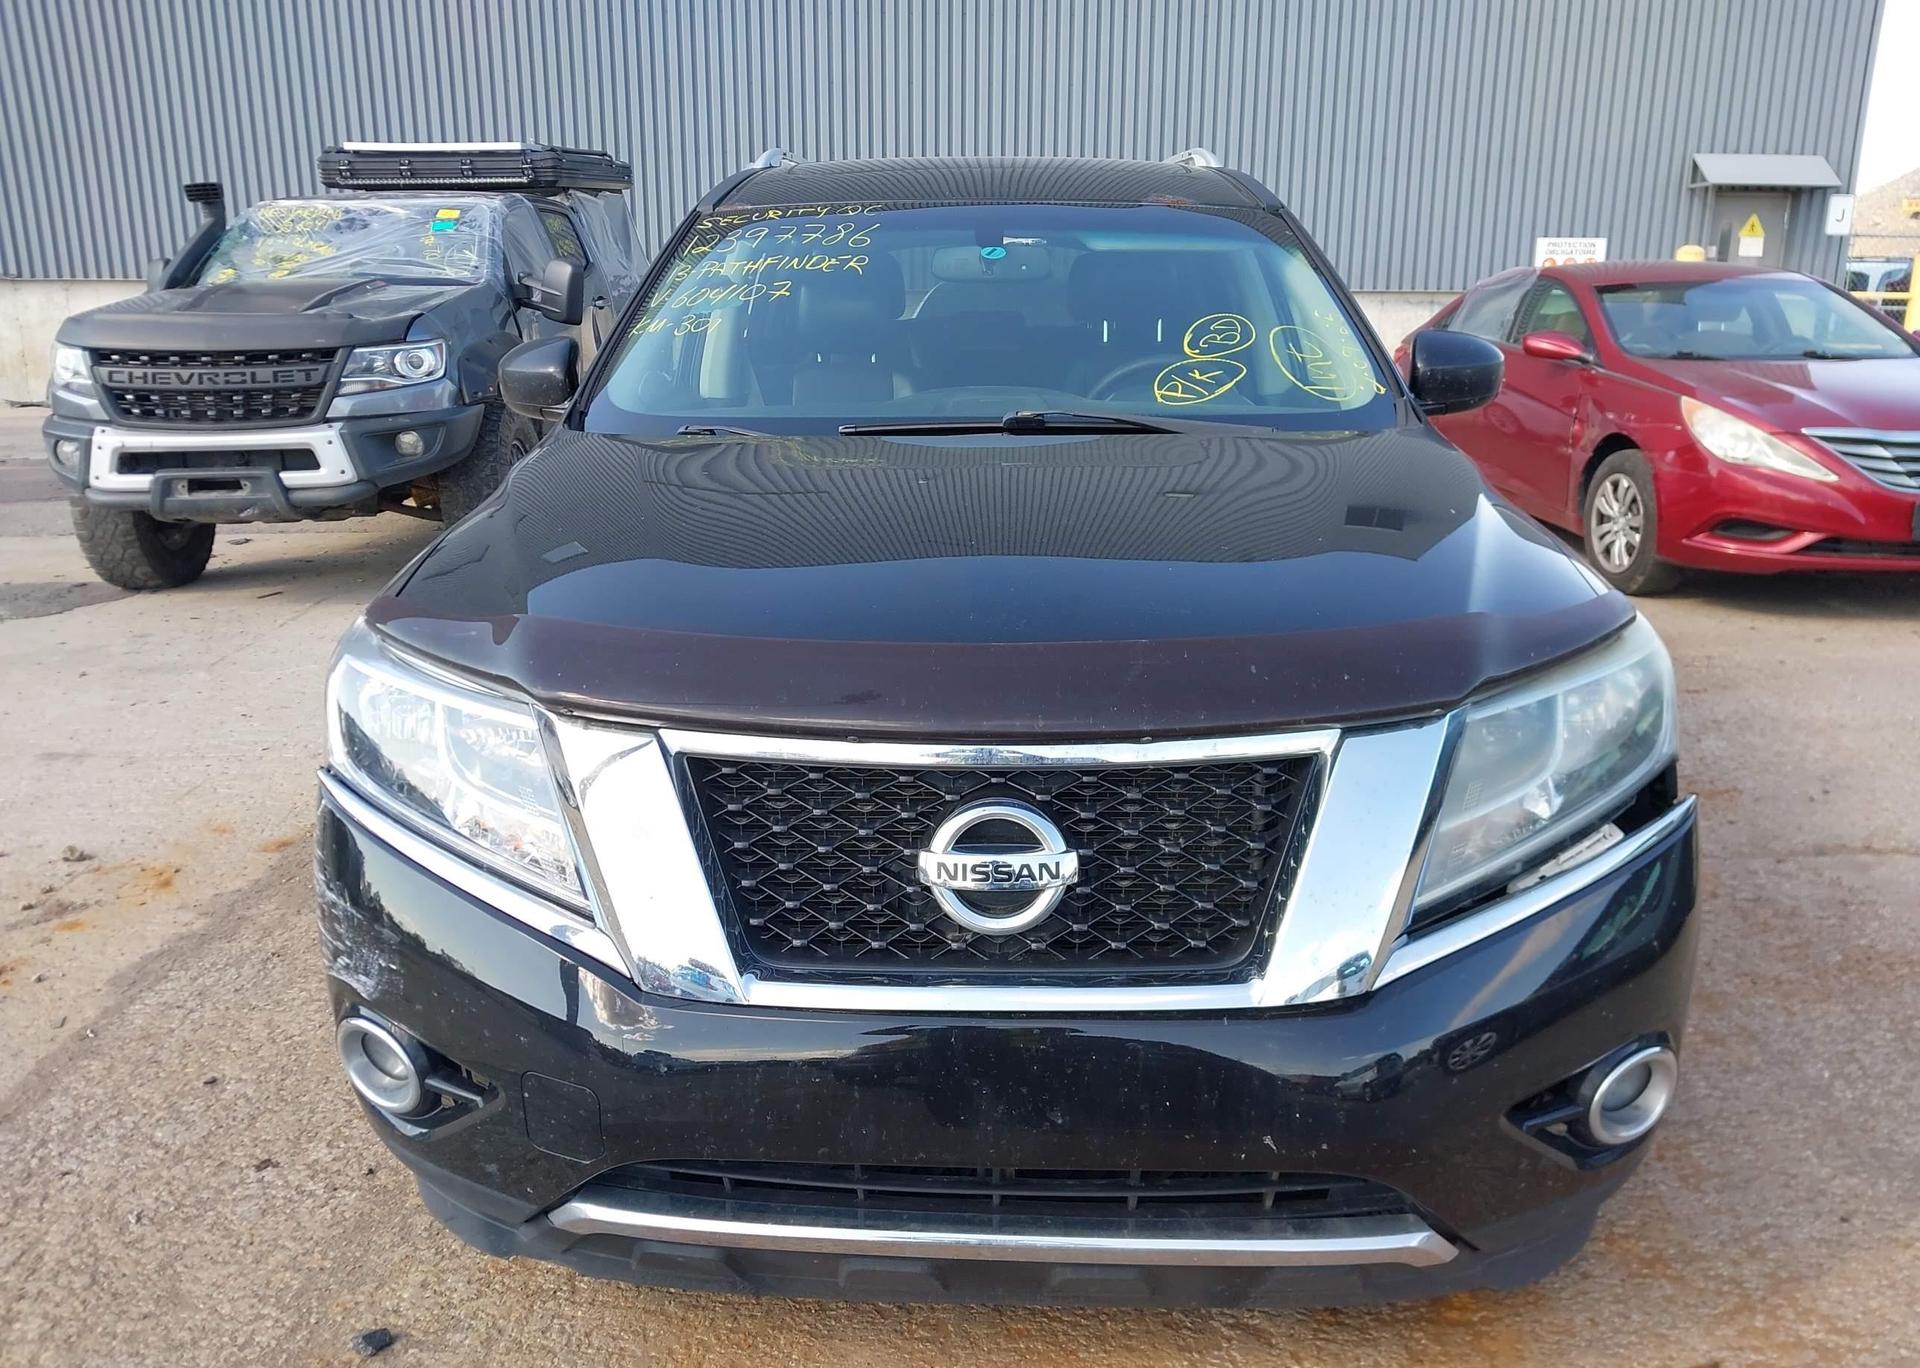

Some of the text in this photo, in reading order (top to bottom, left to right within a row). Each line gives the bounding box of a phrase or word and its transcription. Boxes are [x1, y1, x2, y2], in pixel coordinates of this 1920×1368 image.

[698, 206, 831, 229] SECURITY
[1835, 208, 1845, 222] J
[683, 223, 881, 257] 12397786
[108, 367, 319, 385] CHEVROLET
[937, 861, 1061, 882] NISSAN
